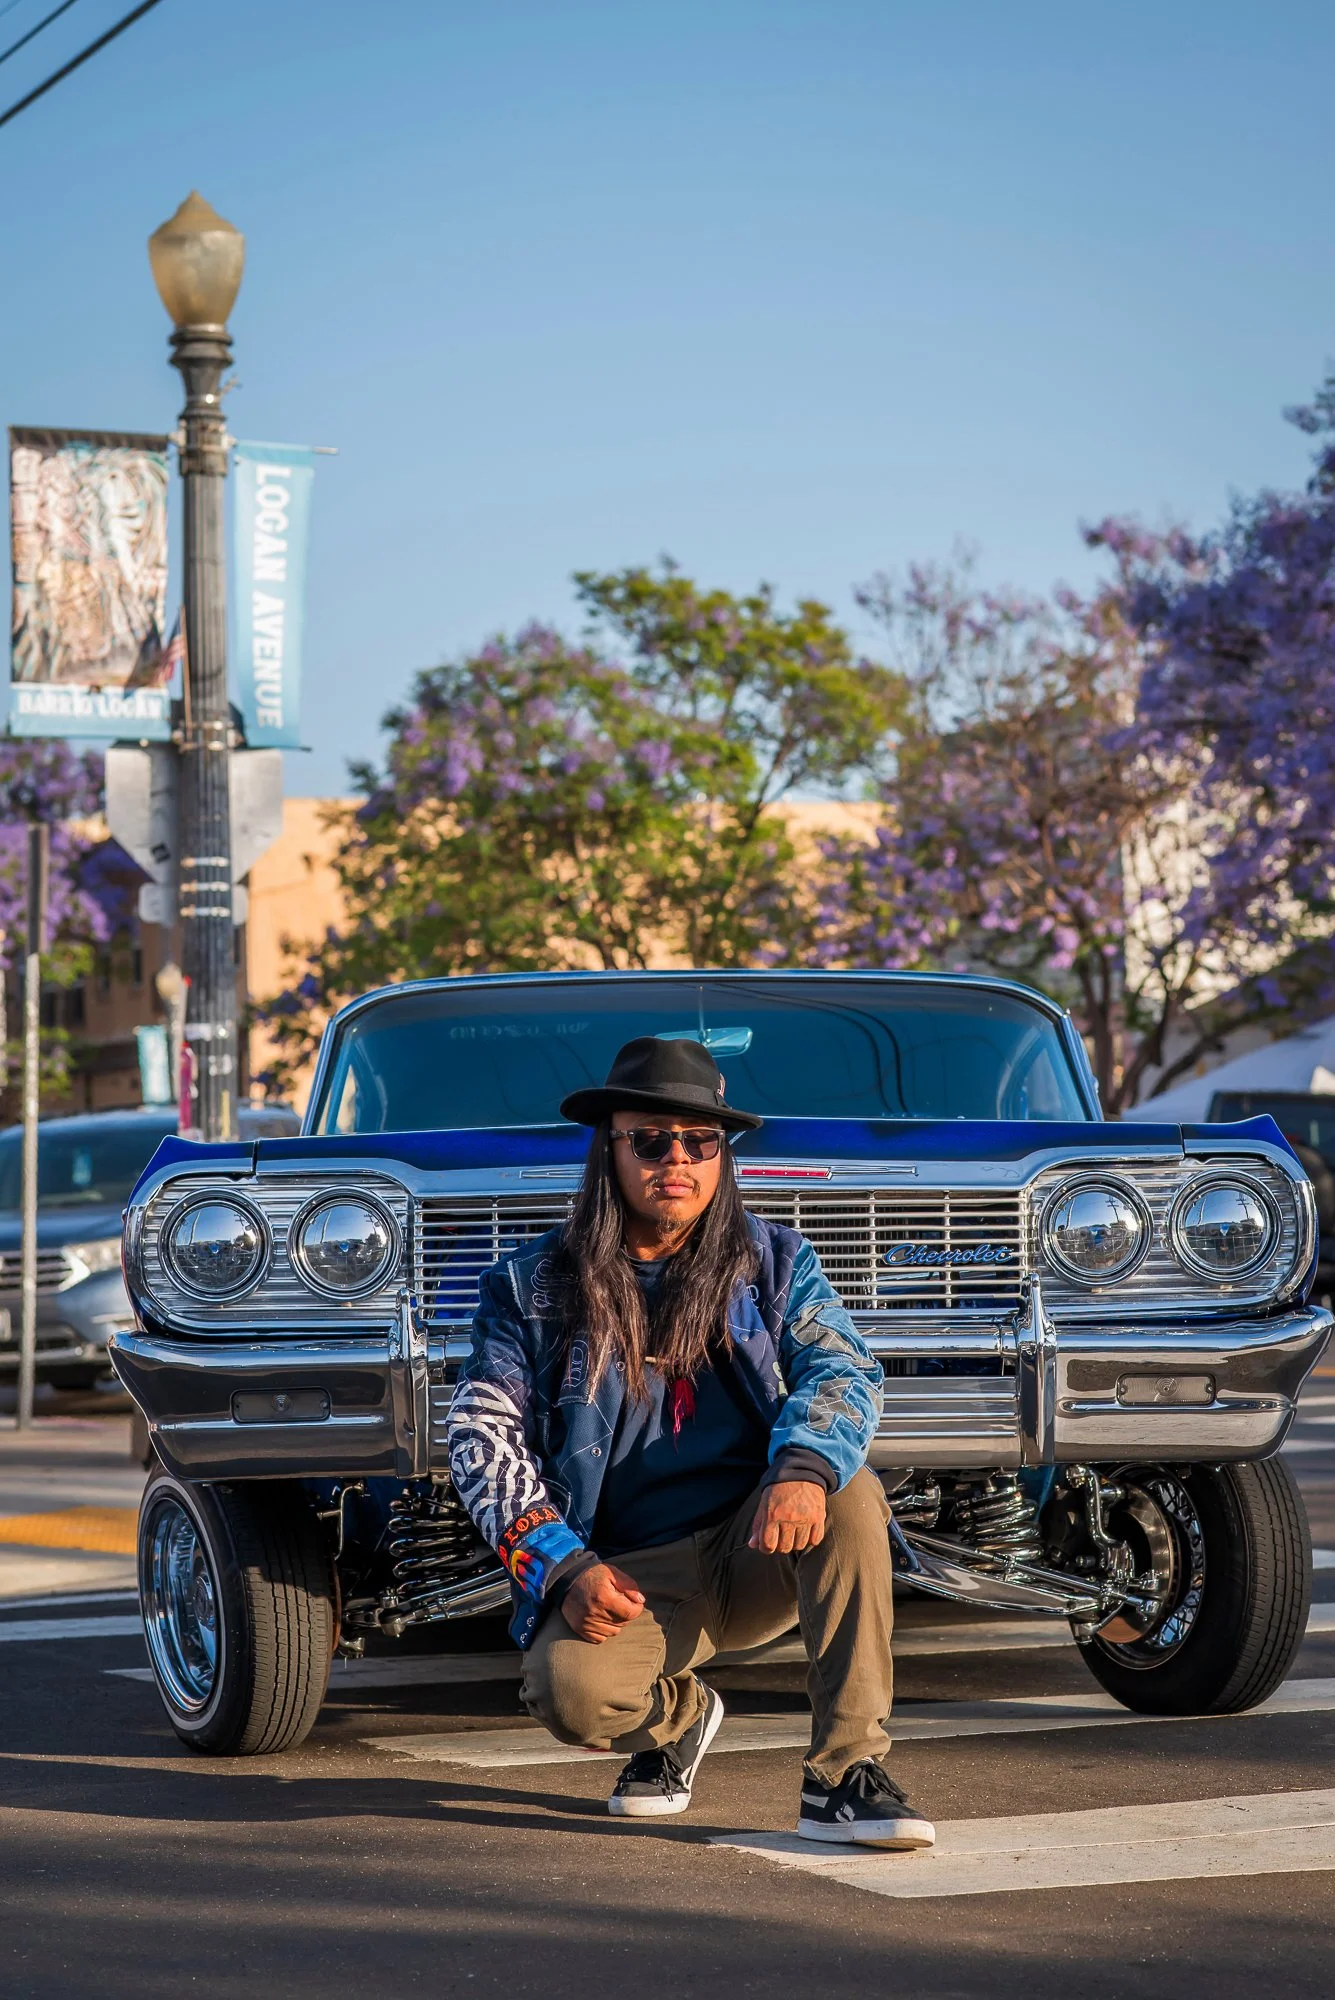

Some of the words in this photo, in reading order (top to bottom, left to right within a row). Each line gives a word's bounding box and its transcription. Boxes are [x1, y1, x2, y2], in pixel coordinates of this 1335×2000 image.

[253, 463, 292, 582] LOGAN
[252, 590, 285, 729] AVENUE
[883, 1243, 1014, 1266] Chevrolet
